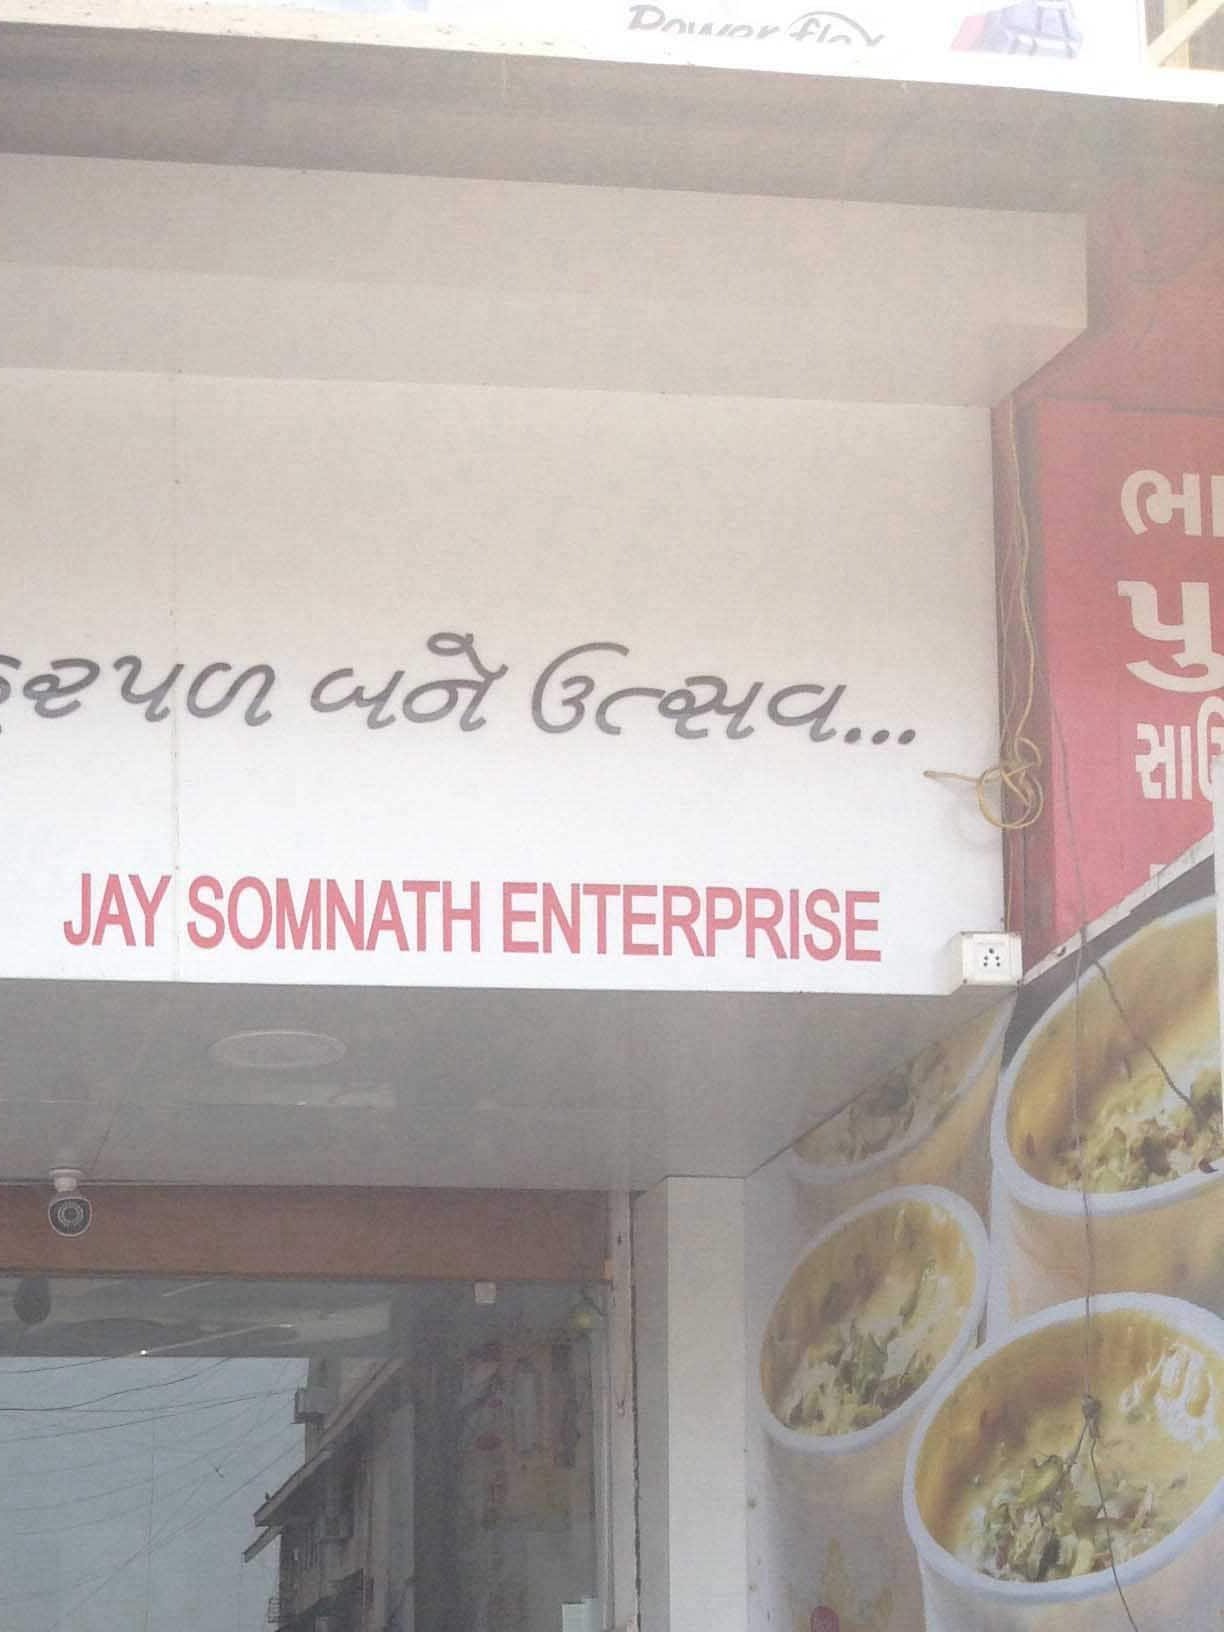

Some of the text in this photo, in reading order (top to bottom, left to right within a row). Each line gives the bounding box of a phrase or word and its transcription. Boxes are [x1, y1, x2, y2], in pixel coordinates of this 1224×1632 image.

[310, 632, 509, 731] બને
[63, 874, 881, 961] JAY SOMNATH ENTERPRISE
